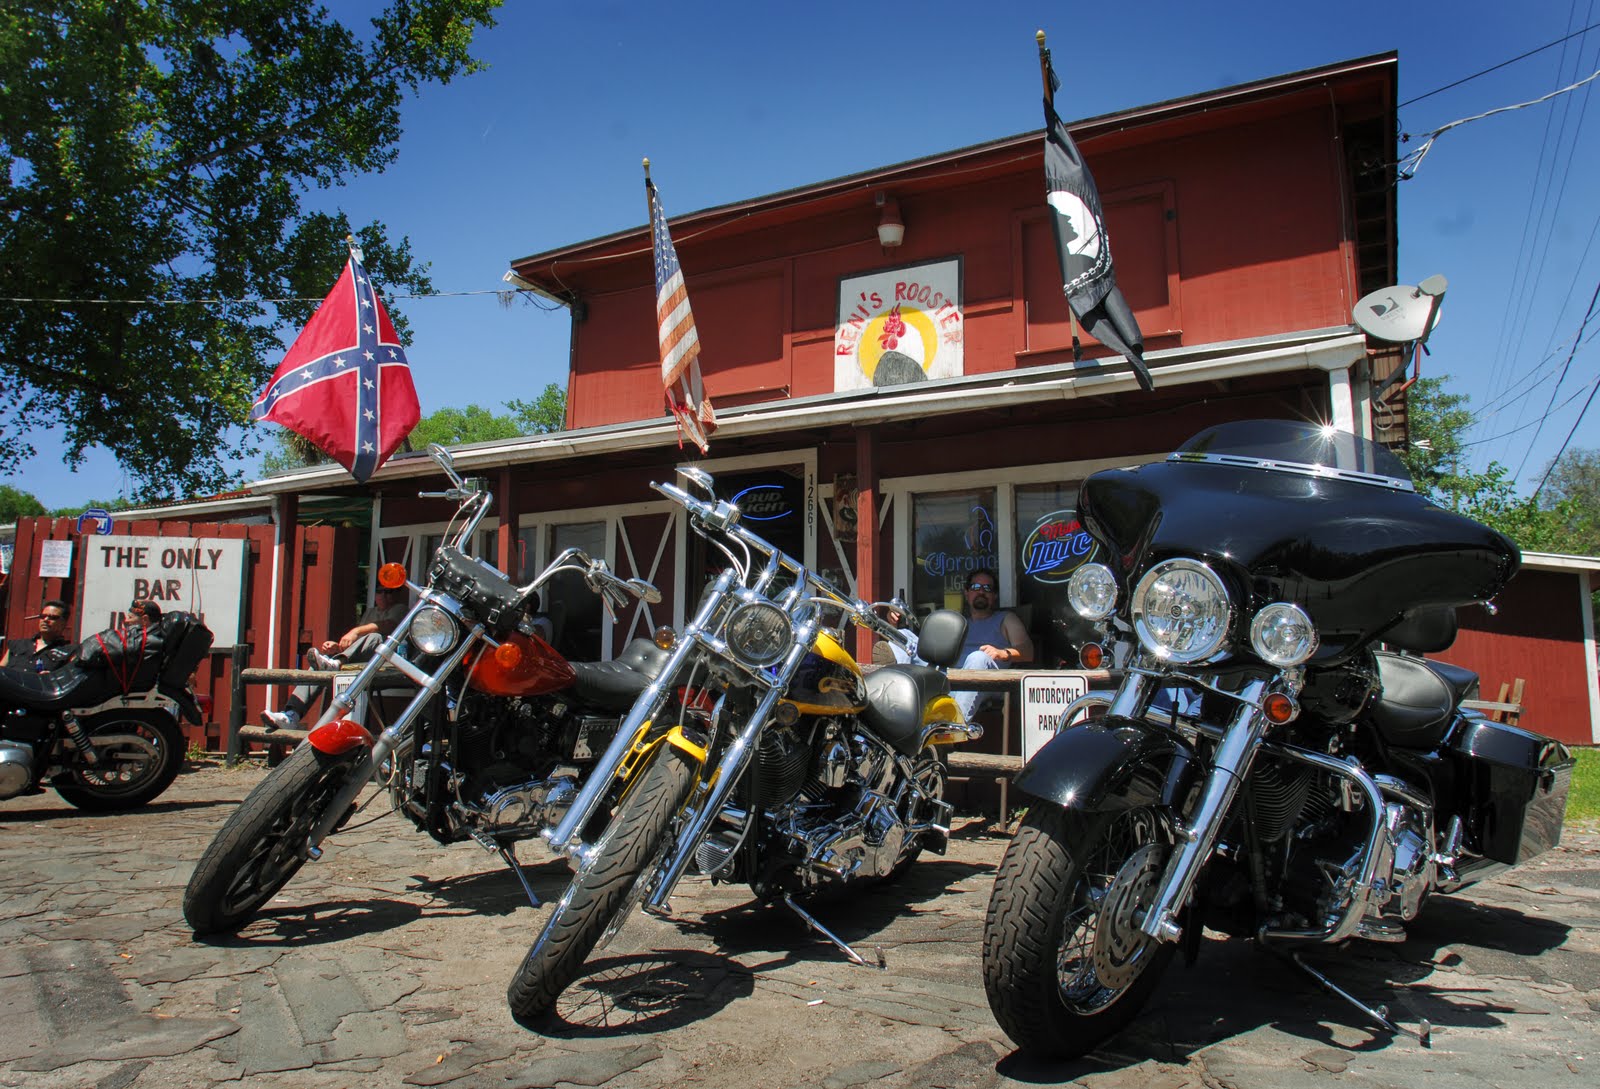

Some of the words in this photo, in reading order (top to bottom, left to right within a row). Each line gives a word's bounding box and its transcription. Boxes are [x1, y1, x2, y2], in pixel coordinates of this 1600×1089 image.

[837, 292, 883, 355] RENI'S
[895, 281, 963, 345] ROOSTER
[744, 501, 788, 513] IGHT
[748, 492, 782, 503] BUD
[100, 546, 149, 568] THE
[160, 548, 223, 570] ONLY
[924, 552, 999, 576] Corona
[1025, 532, 1094, 575] Lite
[134, 578, 181, 600] BAR
[1028, 687, 1080, 704] MOTORCYCLE
